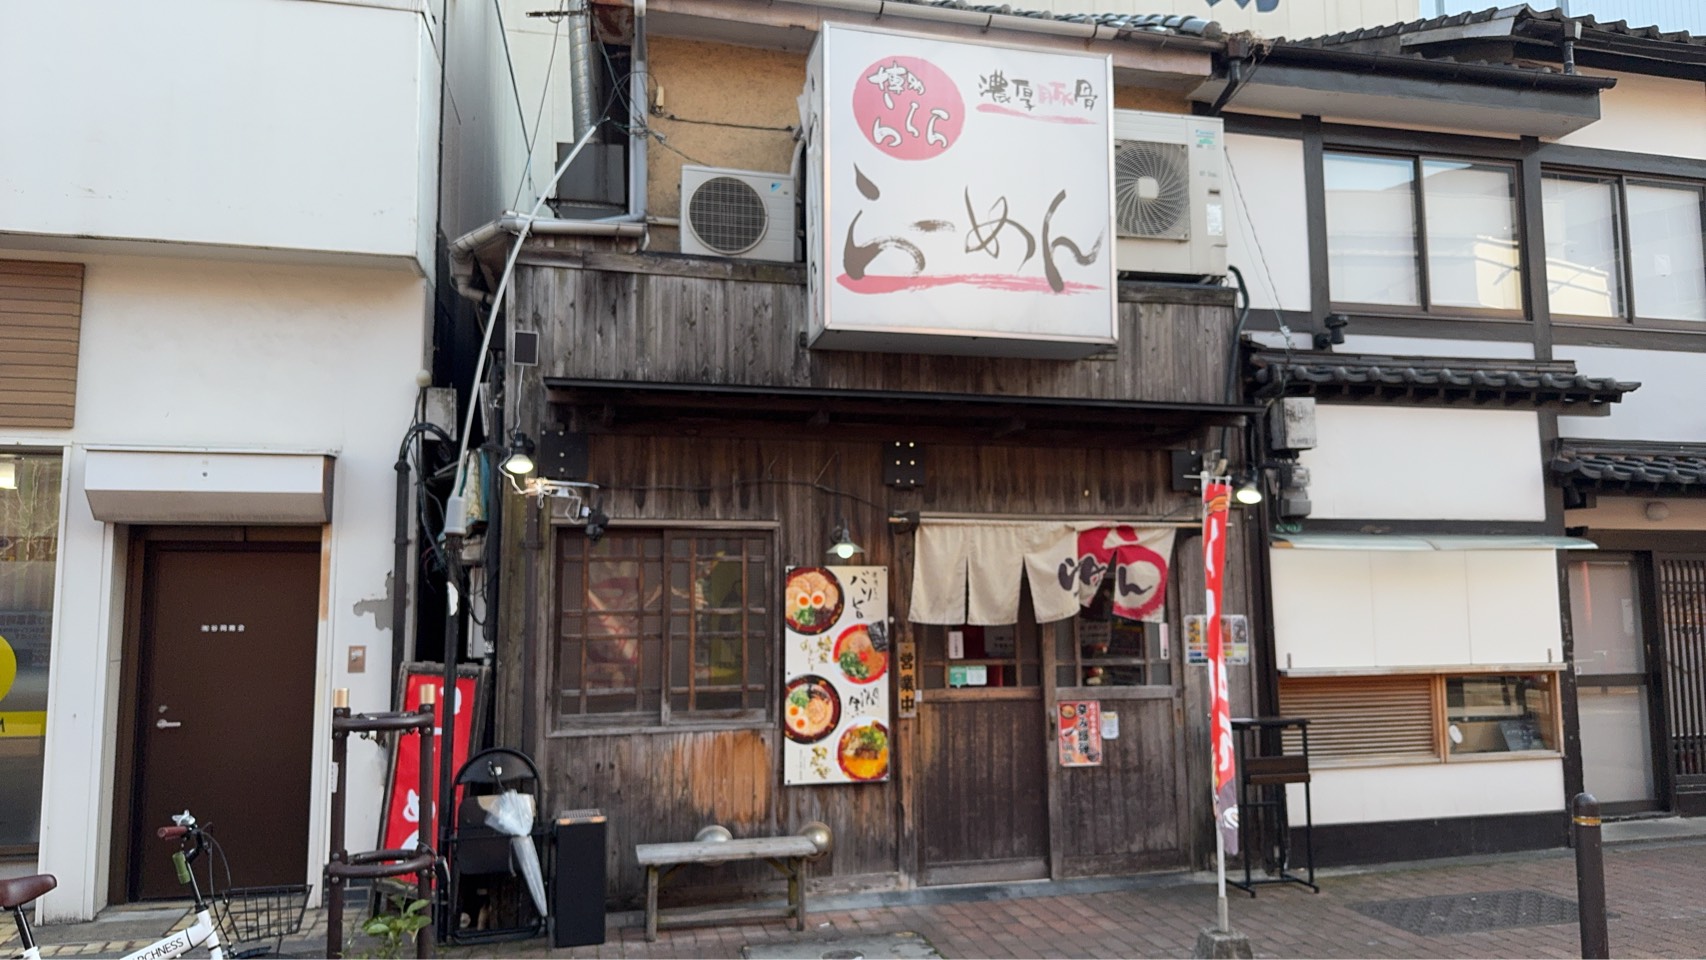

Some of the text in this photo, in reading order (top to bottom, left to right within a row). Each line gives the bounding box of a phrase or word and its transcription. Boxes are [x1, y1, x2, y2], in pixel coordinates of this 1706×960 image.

[978, 69, 1098, 111] 濃厚豚骨
[843, 163, 1106, 293] らーめん
[901, 652, 914, 712] 営業中
